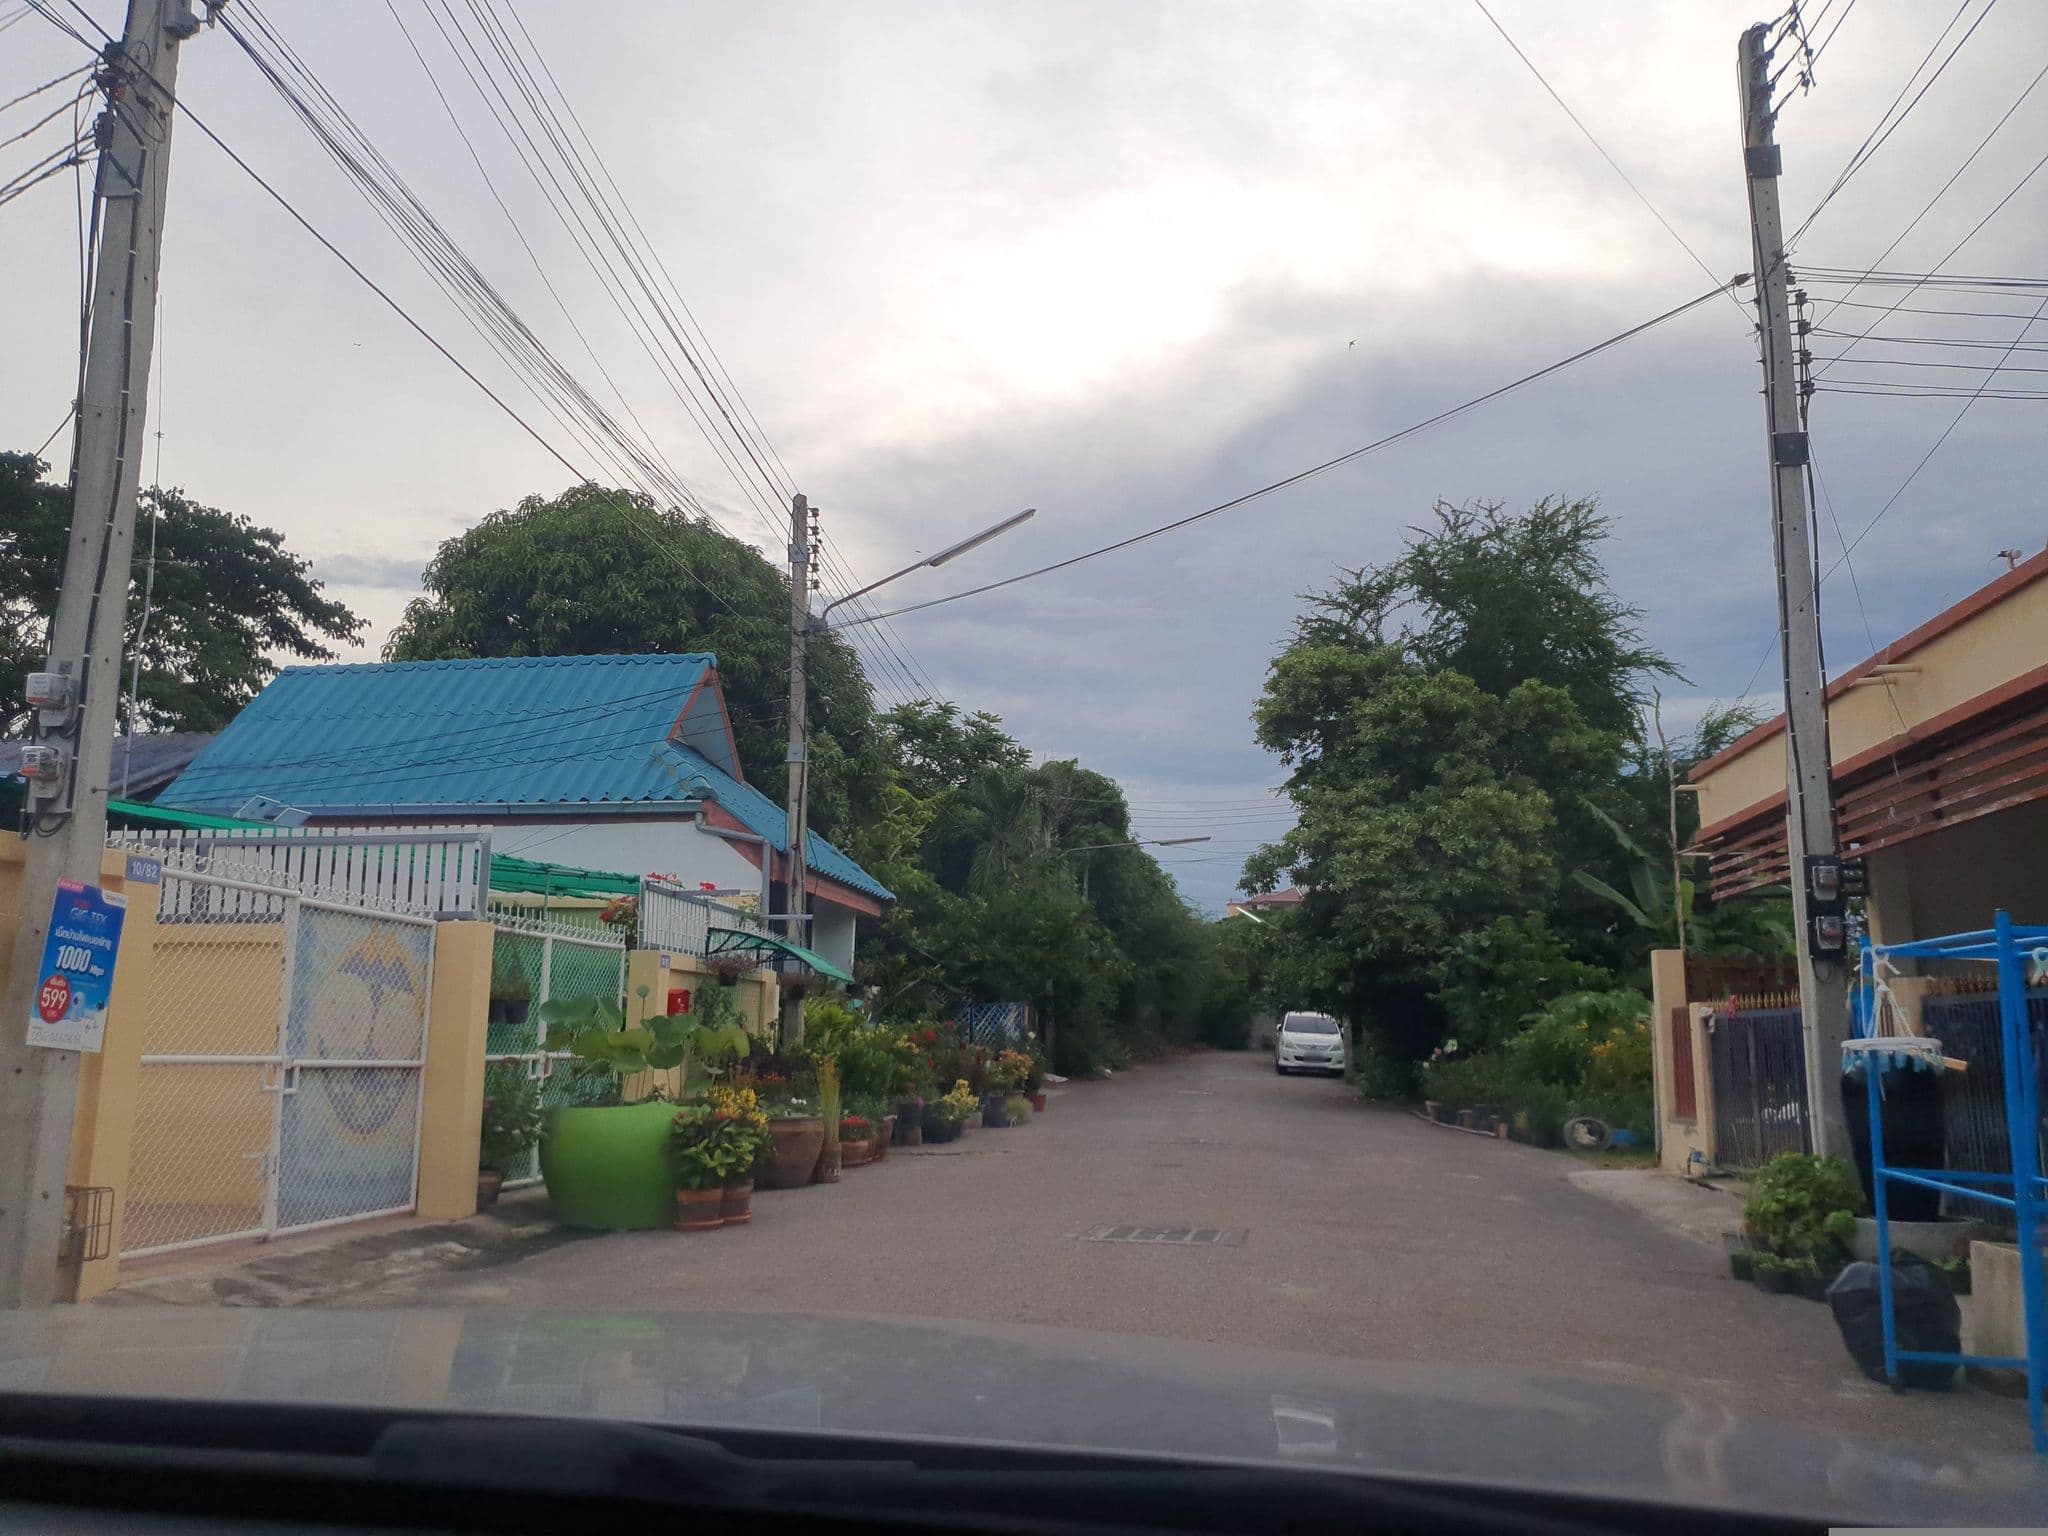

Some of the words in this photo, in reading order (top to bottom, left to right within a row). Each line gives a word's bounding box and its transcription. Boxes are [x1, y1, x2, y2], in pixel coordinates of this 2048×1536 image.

[131, 860, 158, 878] 10/82
[56, 944, 92, 973] 1000
[41, 987, 68, 1010] 599
